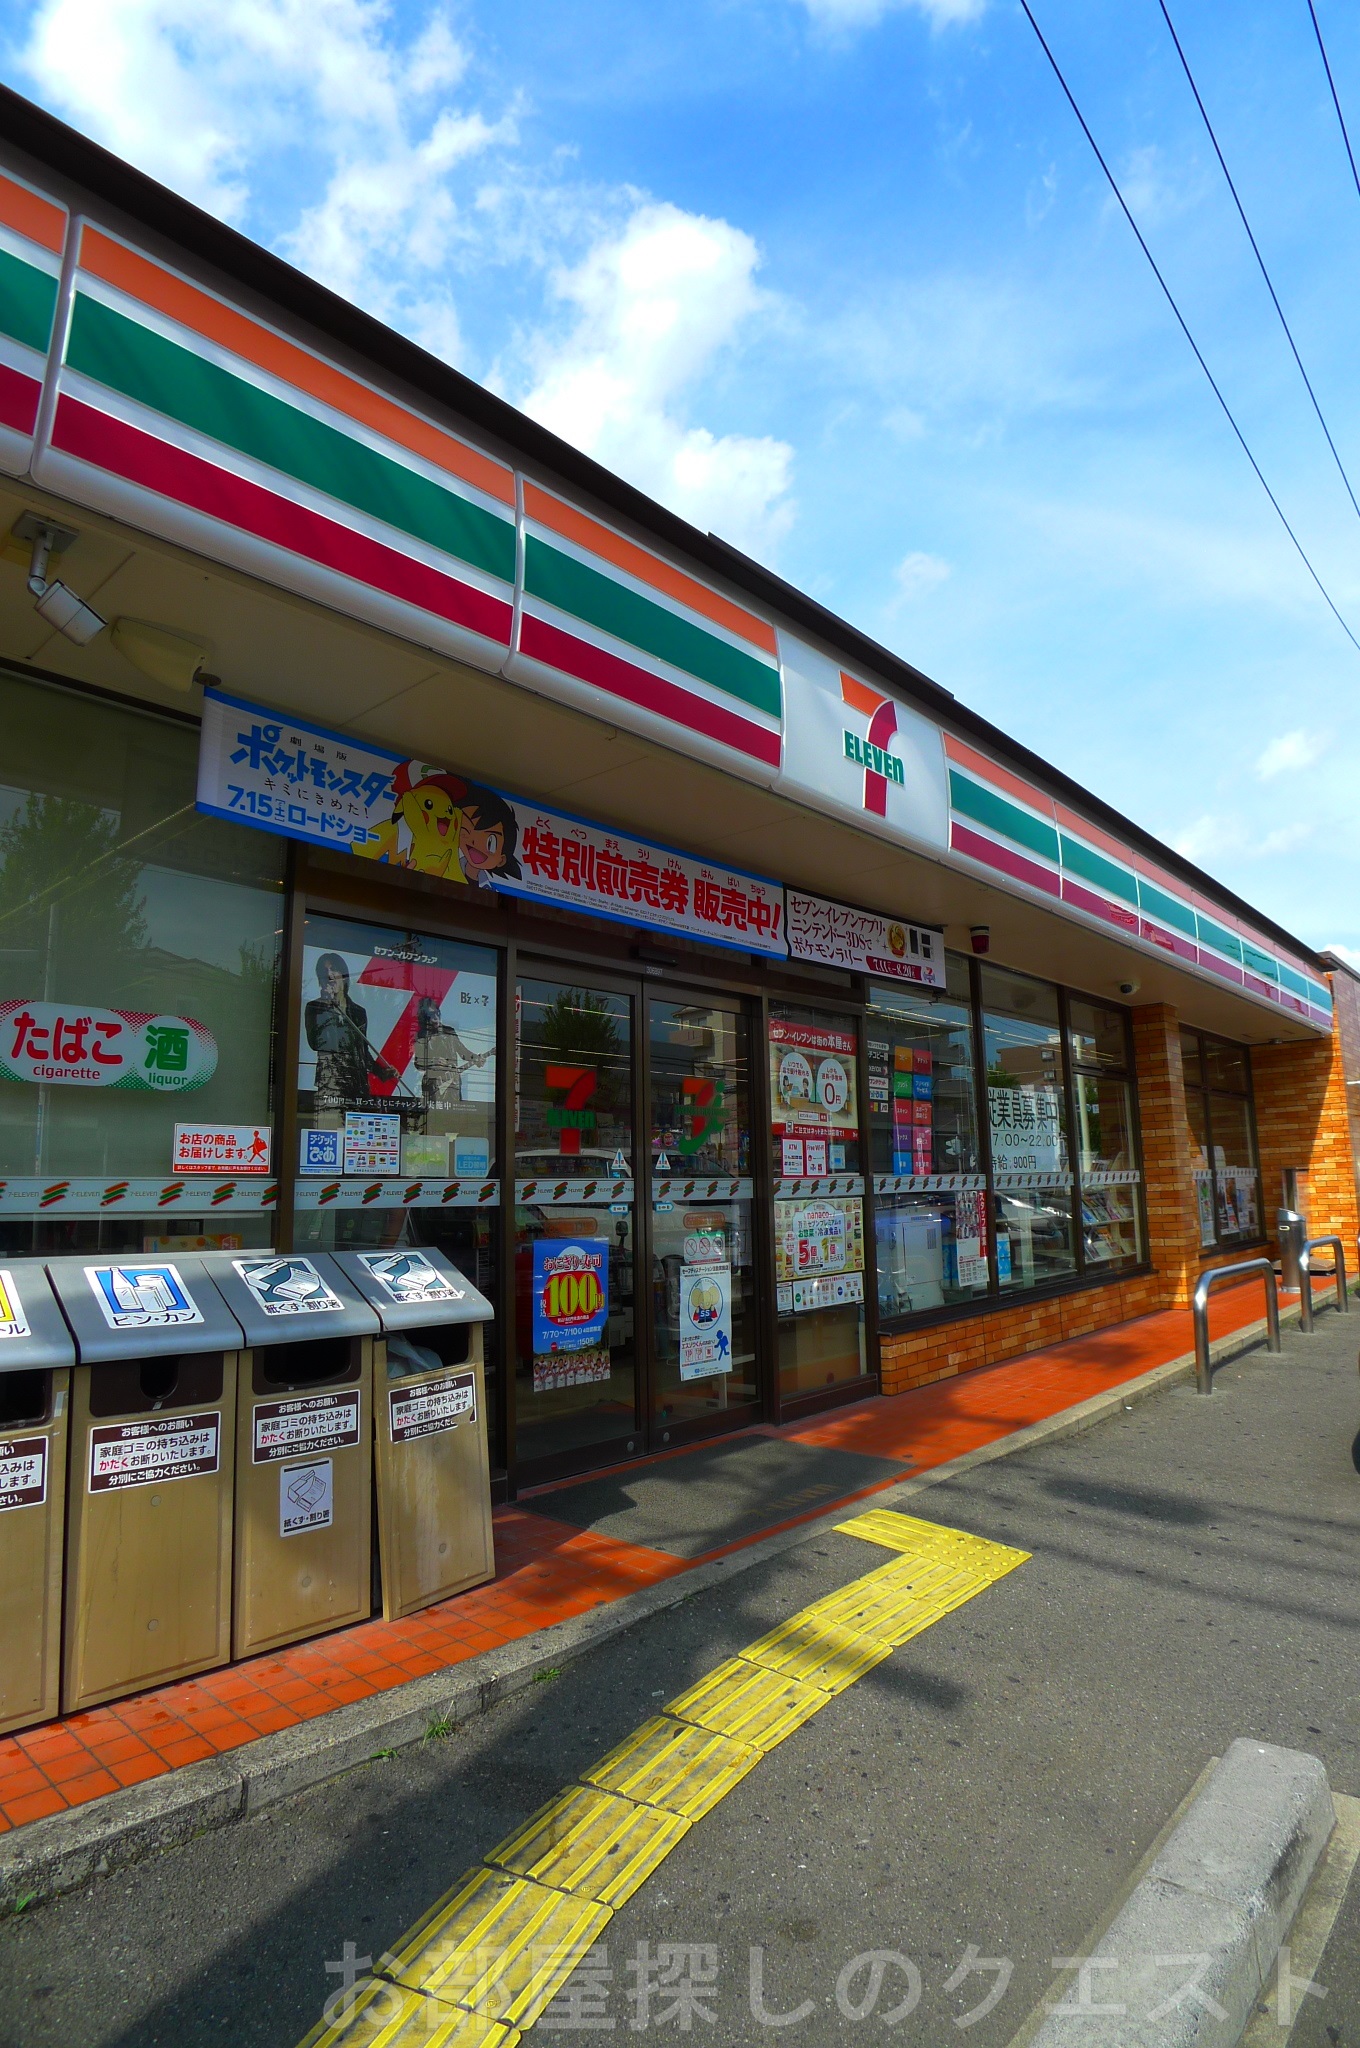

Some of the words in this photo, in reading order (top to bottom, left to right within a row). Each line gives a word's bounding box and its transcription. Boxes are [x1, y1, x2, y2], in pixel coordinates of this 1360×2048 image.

[230, 724, 398, 808] ポケットモンスター
[11, 1012, 123, 1065] たばこ
[144, 1024, 189, 1072] 酒
[33, 1064, 100, 1080] cigarette
[149, 1072, 188, 1086] liquor
[179, 1133, 237, 1146] お店の商品
[178, 1147, 247, 1159] お届けします。
[113, 1313, 196, 1327] ビン・カン
[278, 1396, 338, 1414] お客様へのお願い
[121, 1419, 193, 1437] お客様へのお願い
[261, 1410, 352, 1432] 家庭ゴミの持ち込みは
[261, 1423, 353, 1445] かたくお断りいたします。
[100, 1433, 210, 1458] 家庭ゴミの持ち込みは
[269, 1436, 344, 1457] 分別にご協力ください。
[99, 1447, 212, 1471] かたくお断りいたします。
[109, 1464, 200, 1486] 分別にご協力ください。
[283, 1510, 330, 1528] 紙くず・割り箸
